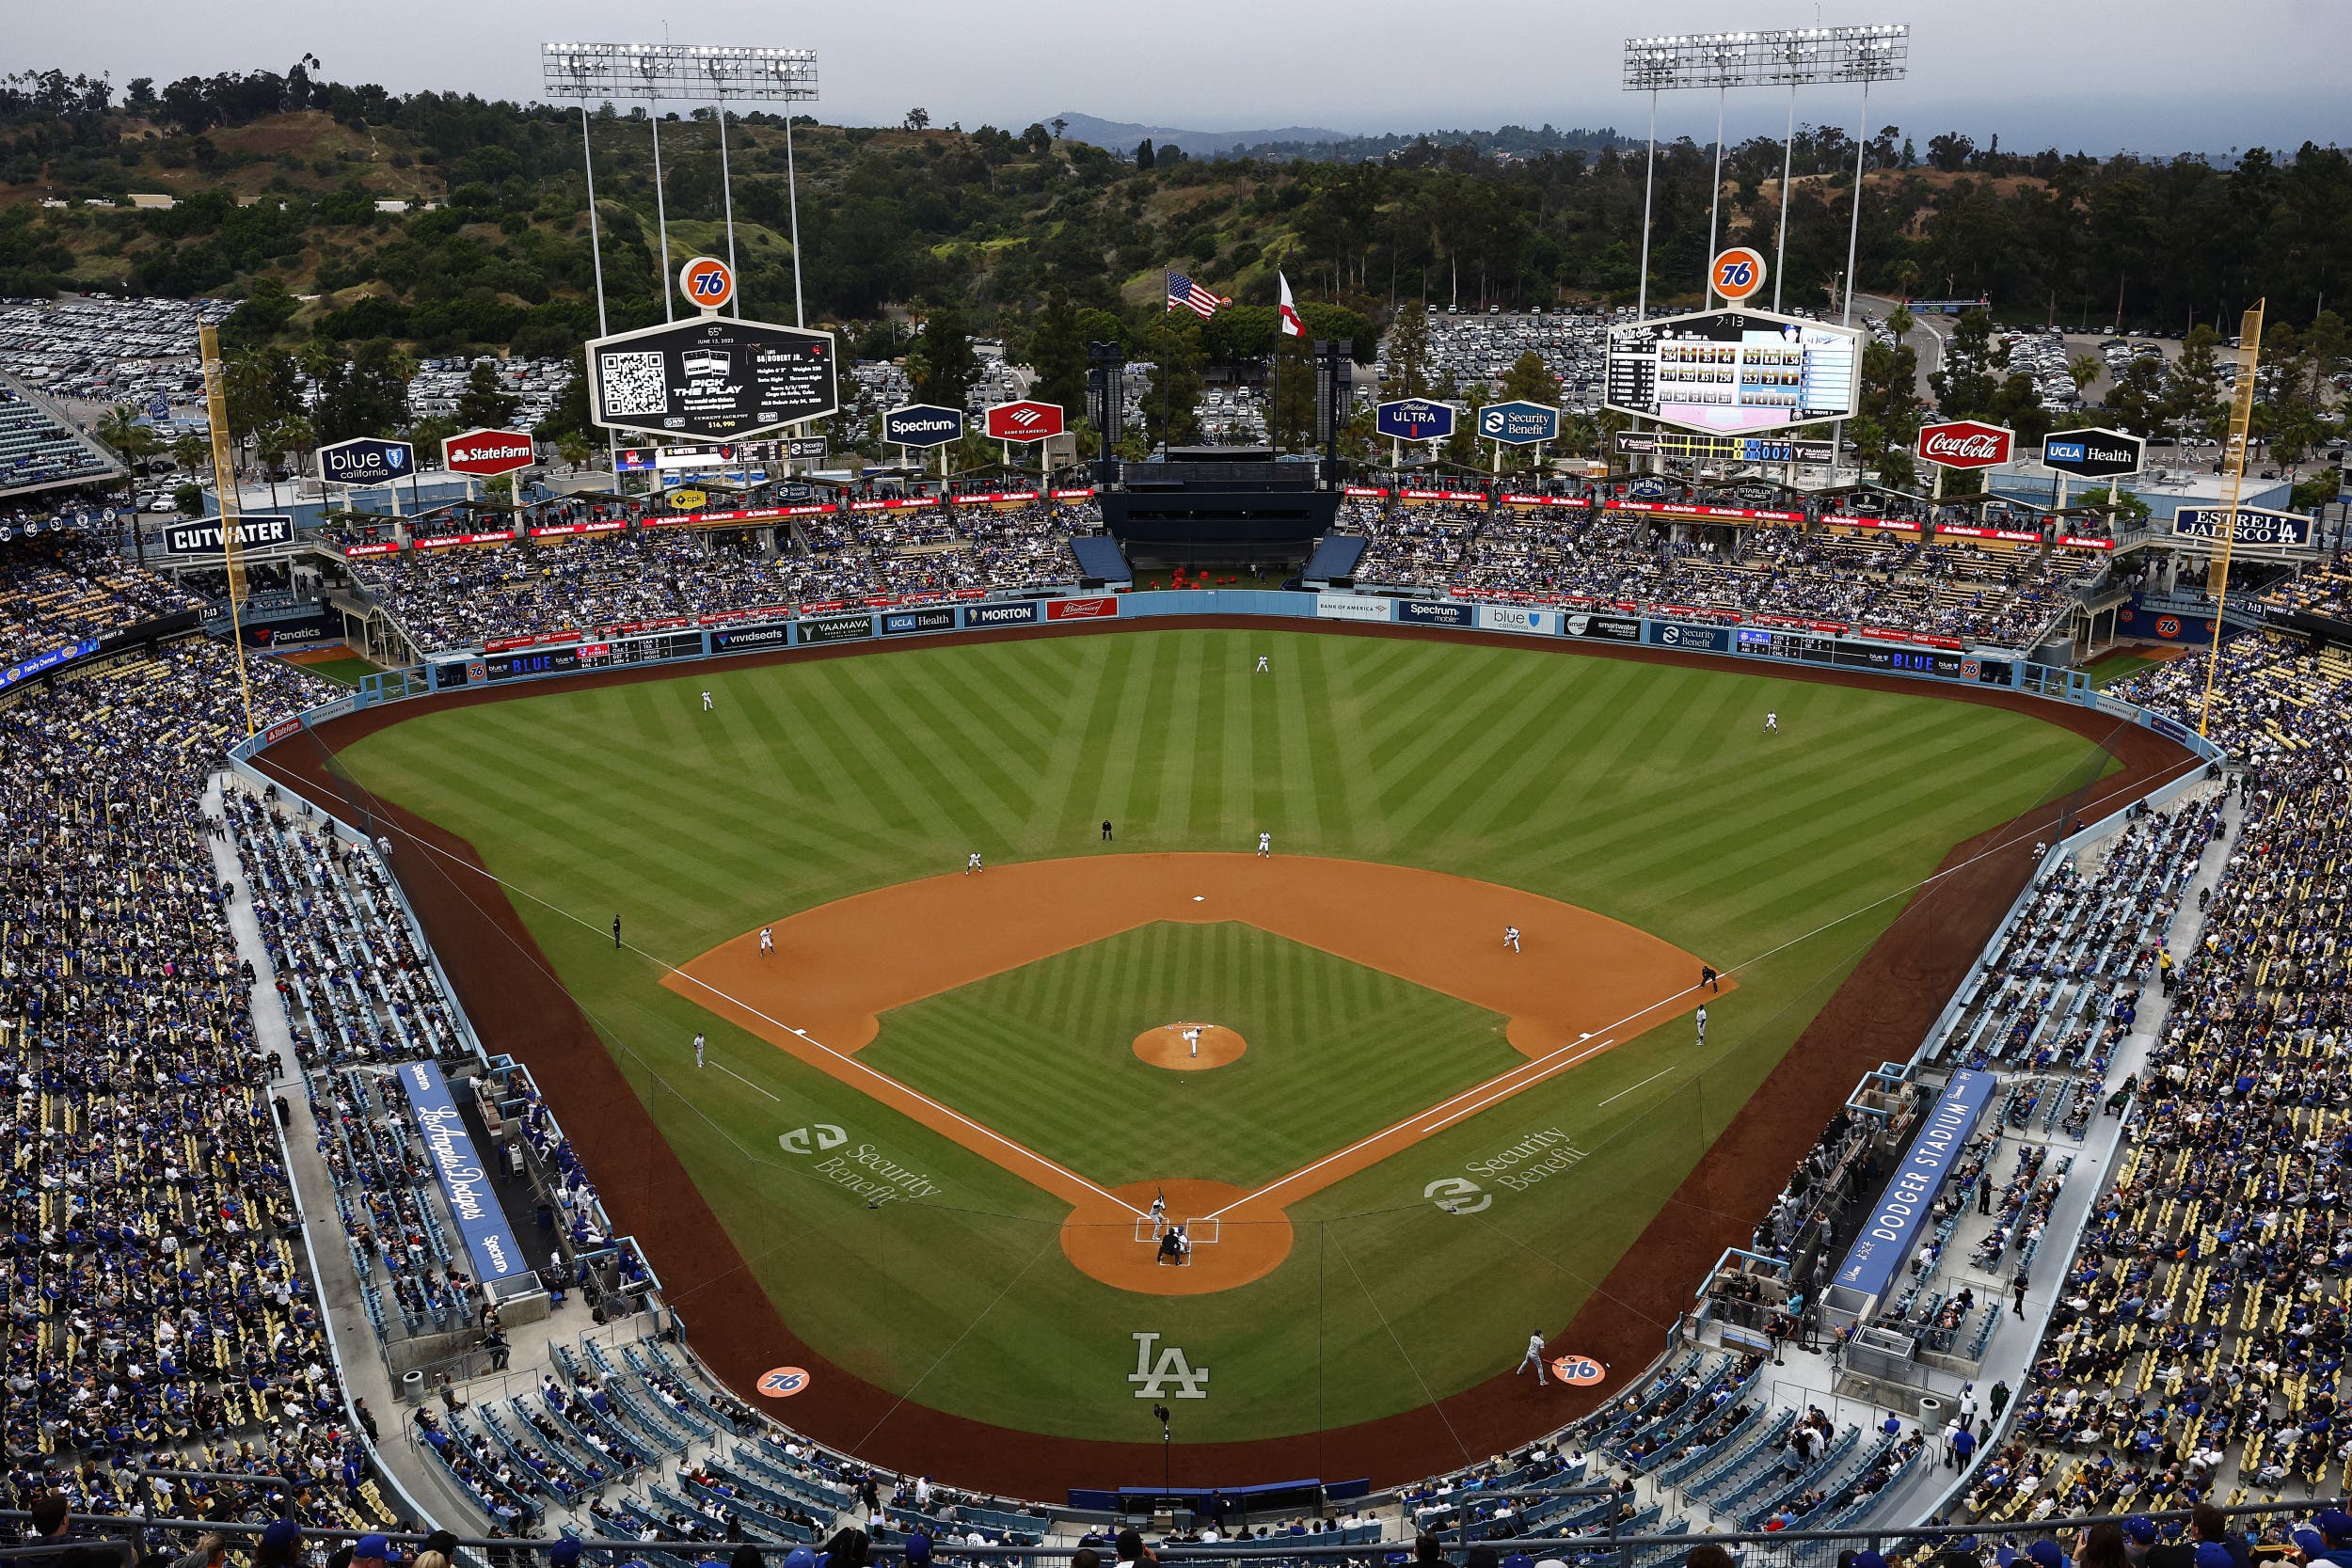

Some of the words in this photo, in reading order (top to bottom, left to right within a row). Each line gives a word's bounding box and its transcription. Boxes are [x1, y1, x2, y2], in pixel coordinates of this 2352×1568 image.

[1720, 261, 1753, 287] 76
[693, 270, 725, 295] 76
[1716, 316, 1744, 327] 7:13
[1611, 328, 1636, 340] White
[1636, 326, 1658, 340] Sox
[768, 354, 791, 362] ROBERT
[1685, 354, 1692, 362] 16
[1703, 354, 1711, 362] 35
[1722, 355, 1731, 363] 44
[1745, 355, 1758, 363] 0-2
[1764, 355, 1779, 364] 8.06
[1784, 356, 1799, 365] 1.56
[691, 378, 725, 388] PICK
[1719, 373, 1732, 382] 250
[1743, 374, 1758, 384] 25.2
[1766, 375, 1775, 384] 23
[673, 388, 703, 397] THE
[706, 385, 744, 395] PLAY
[1392, 412, 1437, 423] ULTRA
[1508, 412, 1549, 425] Security
[891, 419, 952, 436] Spectrum
[1508, 423, 1545, 435] Benefit
[667, 447, 697, 455] K-METER
[803, 442, 824, 451] Security
[1925, 432, 2002, 459] Coca-Cola
[1762, 446, 1769, 459] 0
[1772, 447, 1779, 460] 0
[1783, 447, 1789, 460] 2
[2049, 446, 2081, 458] UCLA
[2087, 447, 2132, 463] Health
[329, 450, 381, 470] blue
[340, 467, 389, 480] california
[1631, 481, 1645, 492] JIM
[1645, 479, 1663, 493] BEAM
[1740, 487, 1771, 496] STARLUX
[687, 494, 702, 504] cpk
[52, 519, 61, 529] 53
[2195, 510, 2278, 530] ESTREL
[0, 531, 10, 539] 39
[25, 524, 36, 534] 42
[174, 521, 284, 549] CUTWATER
[2185, 523, 2272, 542] JALISCO
[203, 608, 217, 619] 7:13
[1065, 604, 1099, 613] Budweiser
[1410, 603, 1457, 616] Spectrum
[2247, 602, 2262, 613] 7:13
[2266, 606, 2286, 615] ROBERT
[891, 619, 913, 627] UCLA
[918, 615, 949, 626] Health
[981, 609, 1031, 621] MORTON
[1434, 614, 1456, 623] mobile
[1493, 610, 1525, 623] blue
[1756, 614, 1772, 623] Coca-Cola
[818, 618, 870, 632] YAAMAVA'
[1498, 622, 1529, 630] california
[1597, 622, 1637, 631] smartwater
[1863, 627, 1881, 636] Coca-Cola
[2160, 620, 2178, 633] 76
[273, 627, 321, 641] Fanatics
[730, 629, 783, 643] vividseats
[1682, 627, 1716, 640] Security
[1912, 633, 1929, 641] Coca-Cola
[1682, 638, 1710, 648] Benefit
[24, 661, 40, 673] Family
[39, 655, 57, 667] Owned
[512, 657, 552, 673] BLUE
[1893, 653, 1933, 672] BLUE
[1963, 664, 1978, 674] 76
[470, 667, 485, 678] 76
[410, 1063, 431, 1091] Spectrum
[427, 1123, 468, 1173] Angeles
[1466, 1127, 1570, 1178] Security
[845, 1144, 942, 1198] Security
[1494, 1145, 1590, 1193] Benefit
[1871, 1173, 1931, 1243] DODGER
[1915, 1102, 1969, 1167] STADIUM
[813, 1156, 898, 1207] Benefit
[447, 1167, 485, 1220] Dodgers
[483, 1234, 509, 1274] Spectrum
[1127, 1331, 1210, 1400] LA
[1560, 1361, 1598, 1380] 76
[764, 1372, 807, 1391] 76
